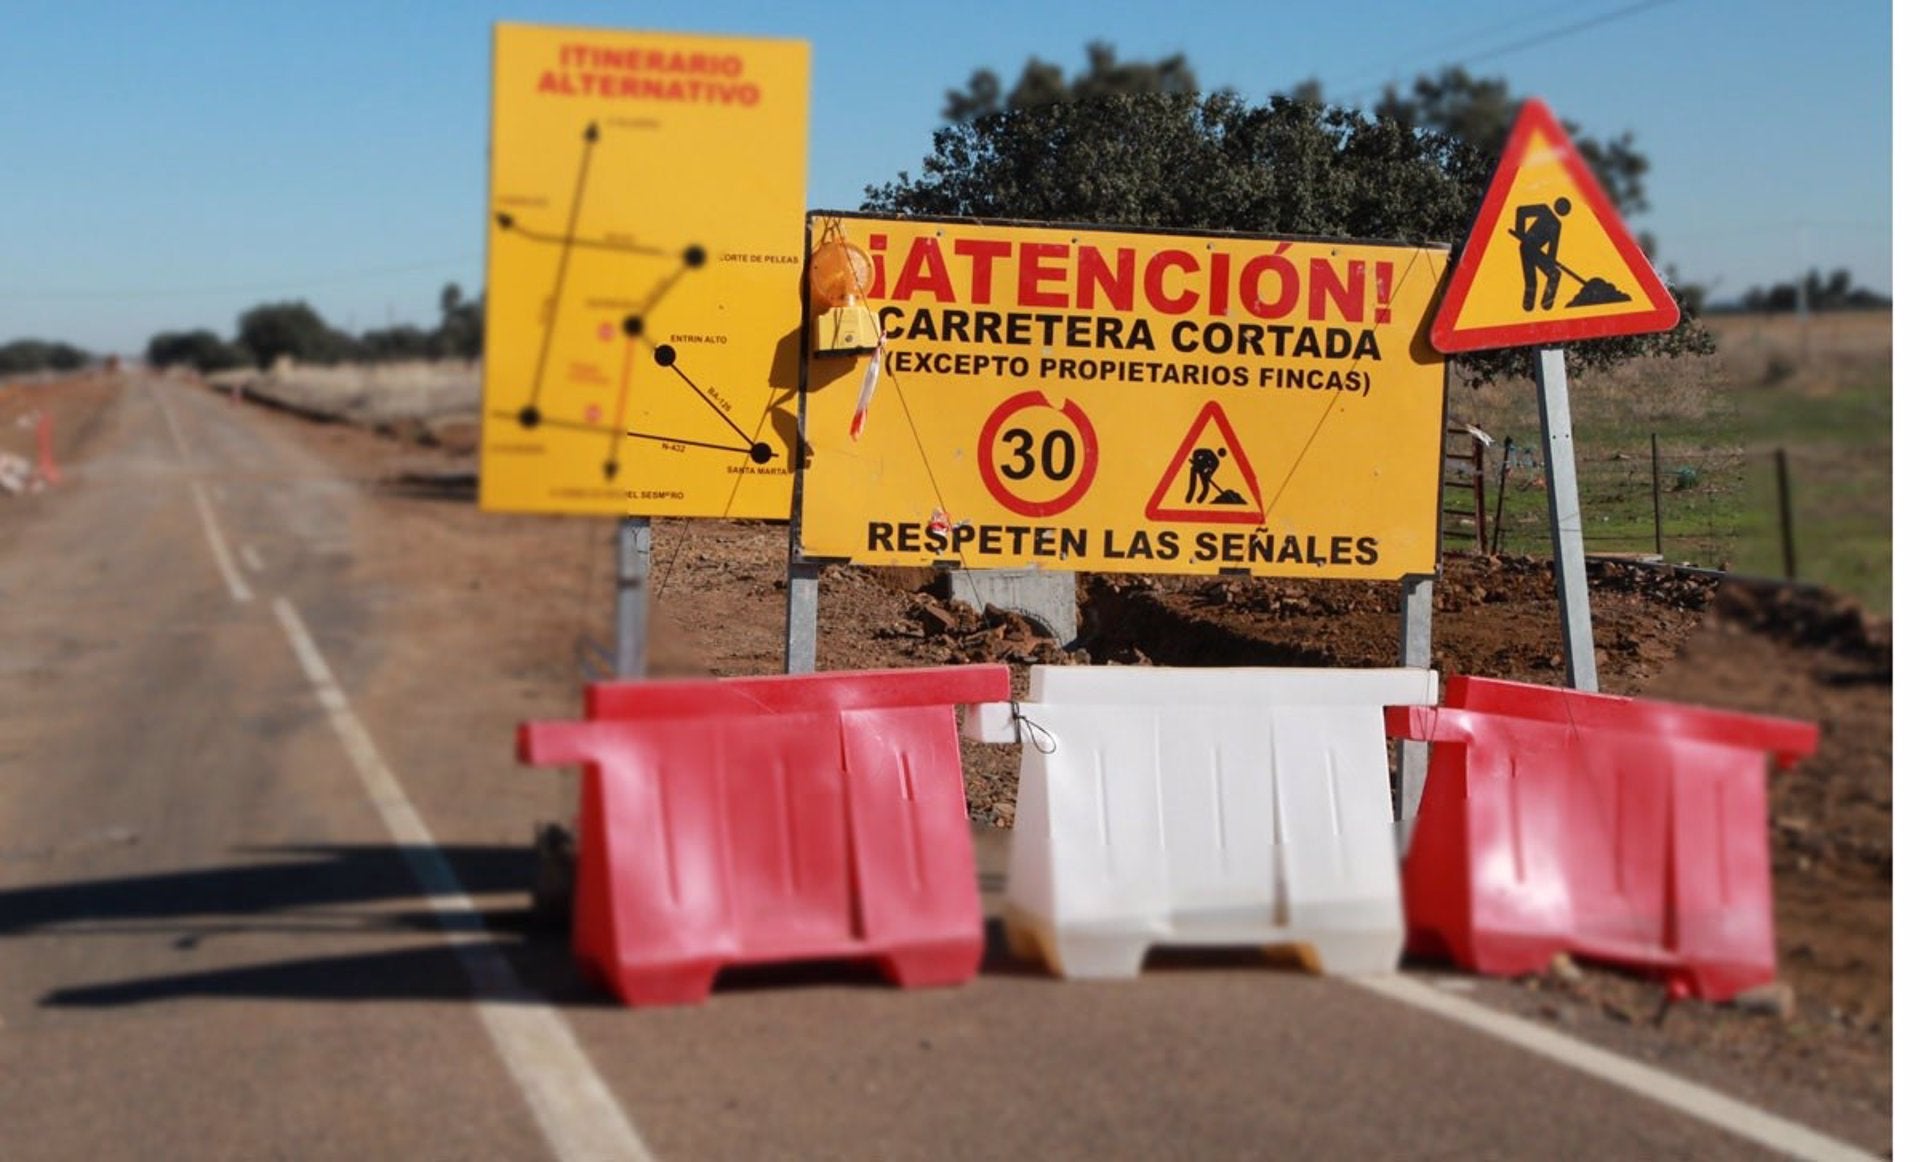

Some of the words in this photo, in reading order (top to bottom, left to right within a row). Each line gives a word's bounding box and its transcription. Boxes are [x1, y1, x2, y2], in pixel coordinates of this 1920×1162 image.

[559, 44, 743, 78] ITINERARIO
[537, 70, 762, 109] ALTERNATIVO
[720, 254, 748, 262] ORTE
[750, 255, 762, 263] DE
[764, 255, 799, 264] PELEAS
[866, 234, 1394, 325] ¡ATENCIÓN!
[704, 335, 728, 344] ALTO
[879, 306, 1155, 349] CARRETERA
[1171, 320, 1381, 361] CORTADA
[885, 351, 1029, 377] (EXCEPTO
[1040, 358, 1249, 387] PROPIETARIOS
[1259, 367, 1370, 397] FINCAS)
[727, 466, 755, 474] SANTA
[757, 466, 787, 475] MARTA
[1000, 428, 1076, 481] 30
[868, 522, 1087, 558] RESPETEN
[1103, 530, 1180, 560] LAS
[1195, 526, 1379, 566] SEÑALES
